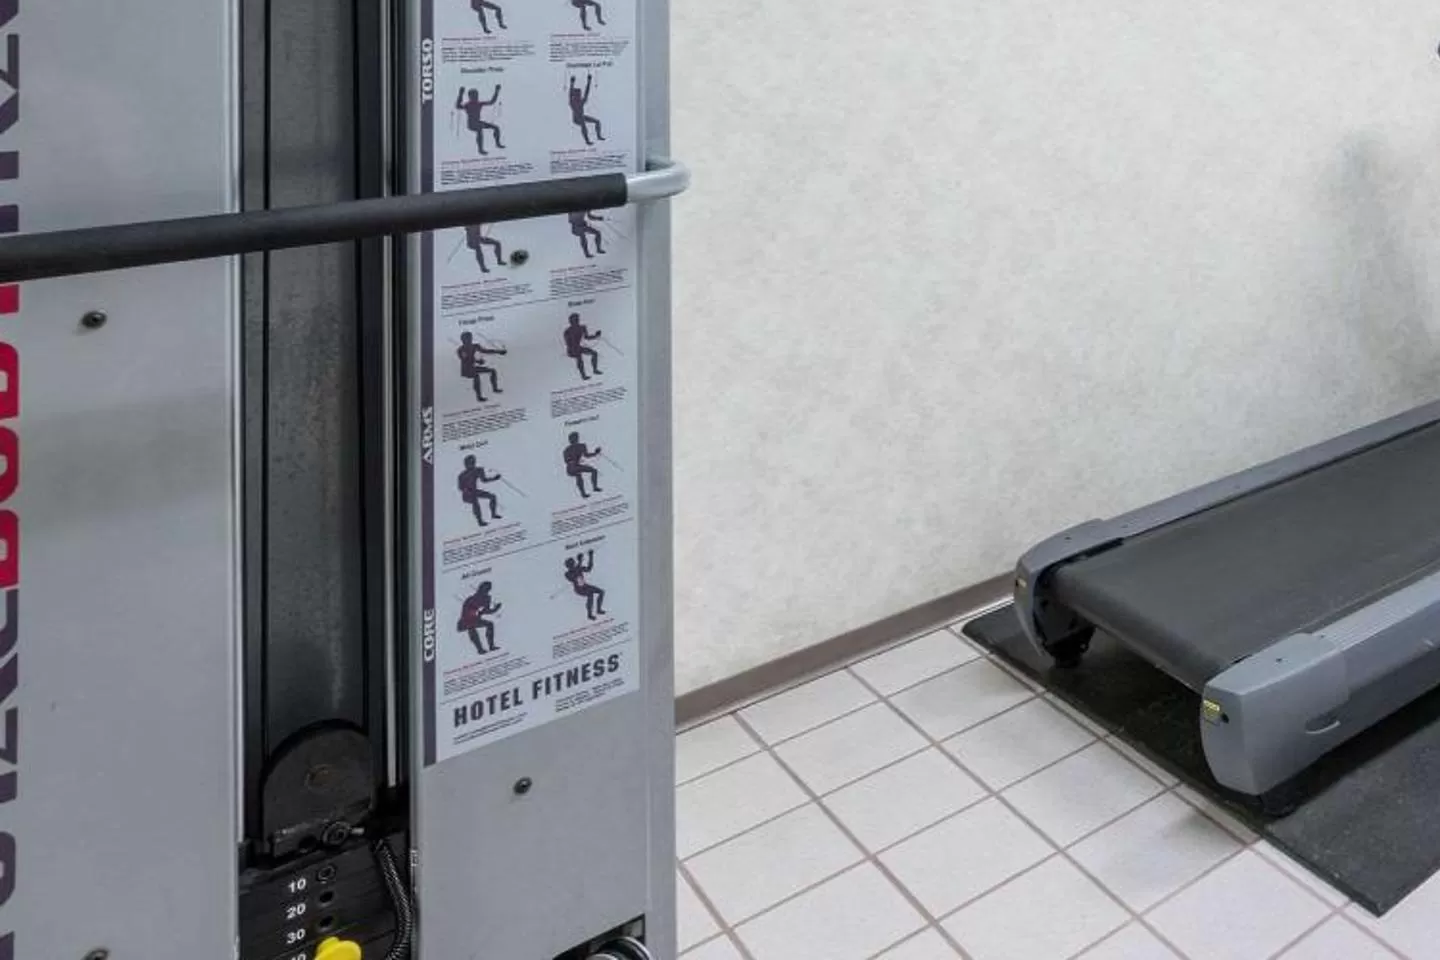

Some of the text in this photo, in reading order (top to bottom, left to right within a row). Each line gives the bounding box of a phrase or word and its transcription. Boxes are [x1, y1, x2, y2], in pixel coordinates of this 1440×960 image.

[422, 38, 434, 103] TORSO
[421, 406, 434, 465] ARMS
[423, 608, 436, 663] CORE
[453, 687, 524, 729] HOTEL
[532, 653, 620, 701] FITNESS
[287, 903, 306, 919] 20
[288, 878, 306, 893] 10
[287, 928, 306, 944] 30
